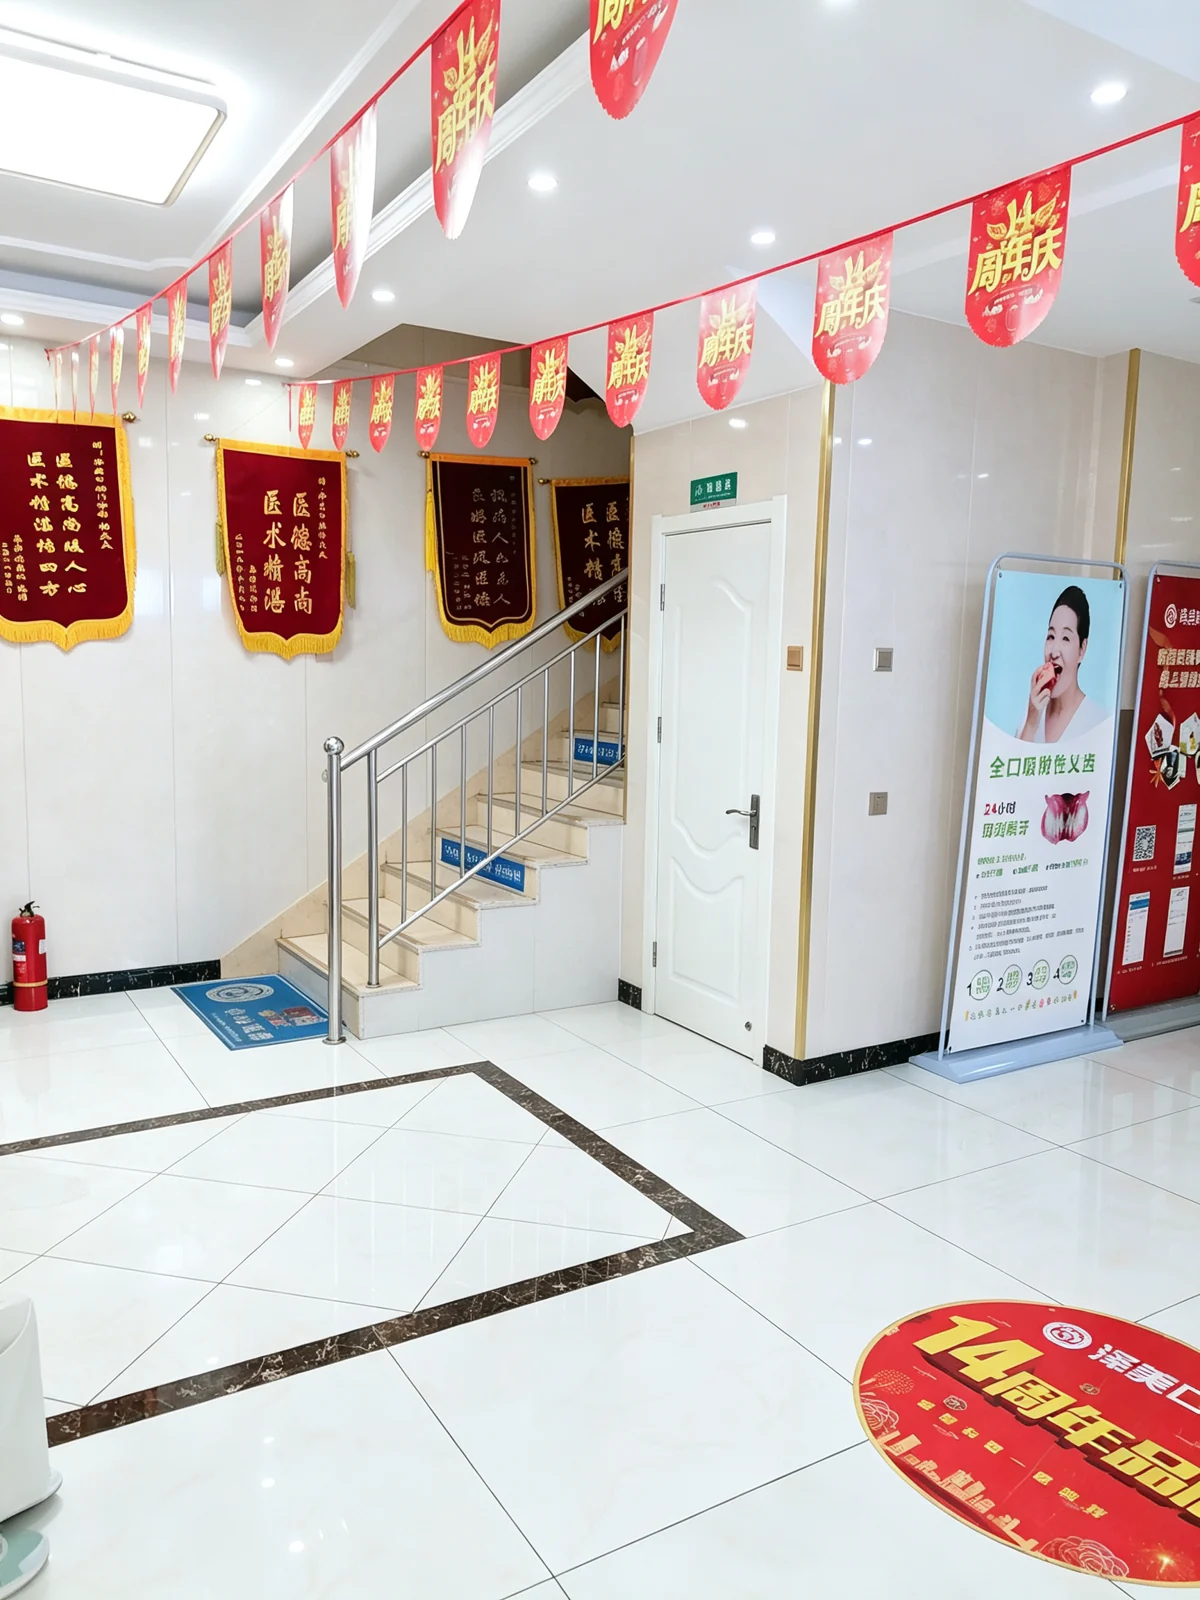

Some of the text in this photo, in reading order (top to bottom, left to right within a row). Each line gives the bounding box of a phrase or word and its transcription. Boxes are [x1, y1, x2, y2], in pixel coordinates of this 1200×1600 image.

[967, 226, 1064, 296] 周年庆
[698, 322, 754, 369] 周年庆
[814, 283, 888, 338] 周年庆
[262, 488, 287, 615] 医术精湛
[290, 491, 314, 615] 医德高尚
